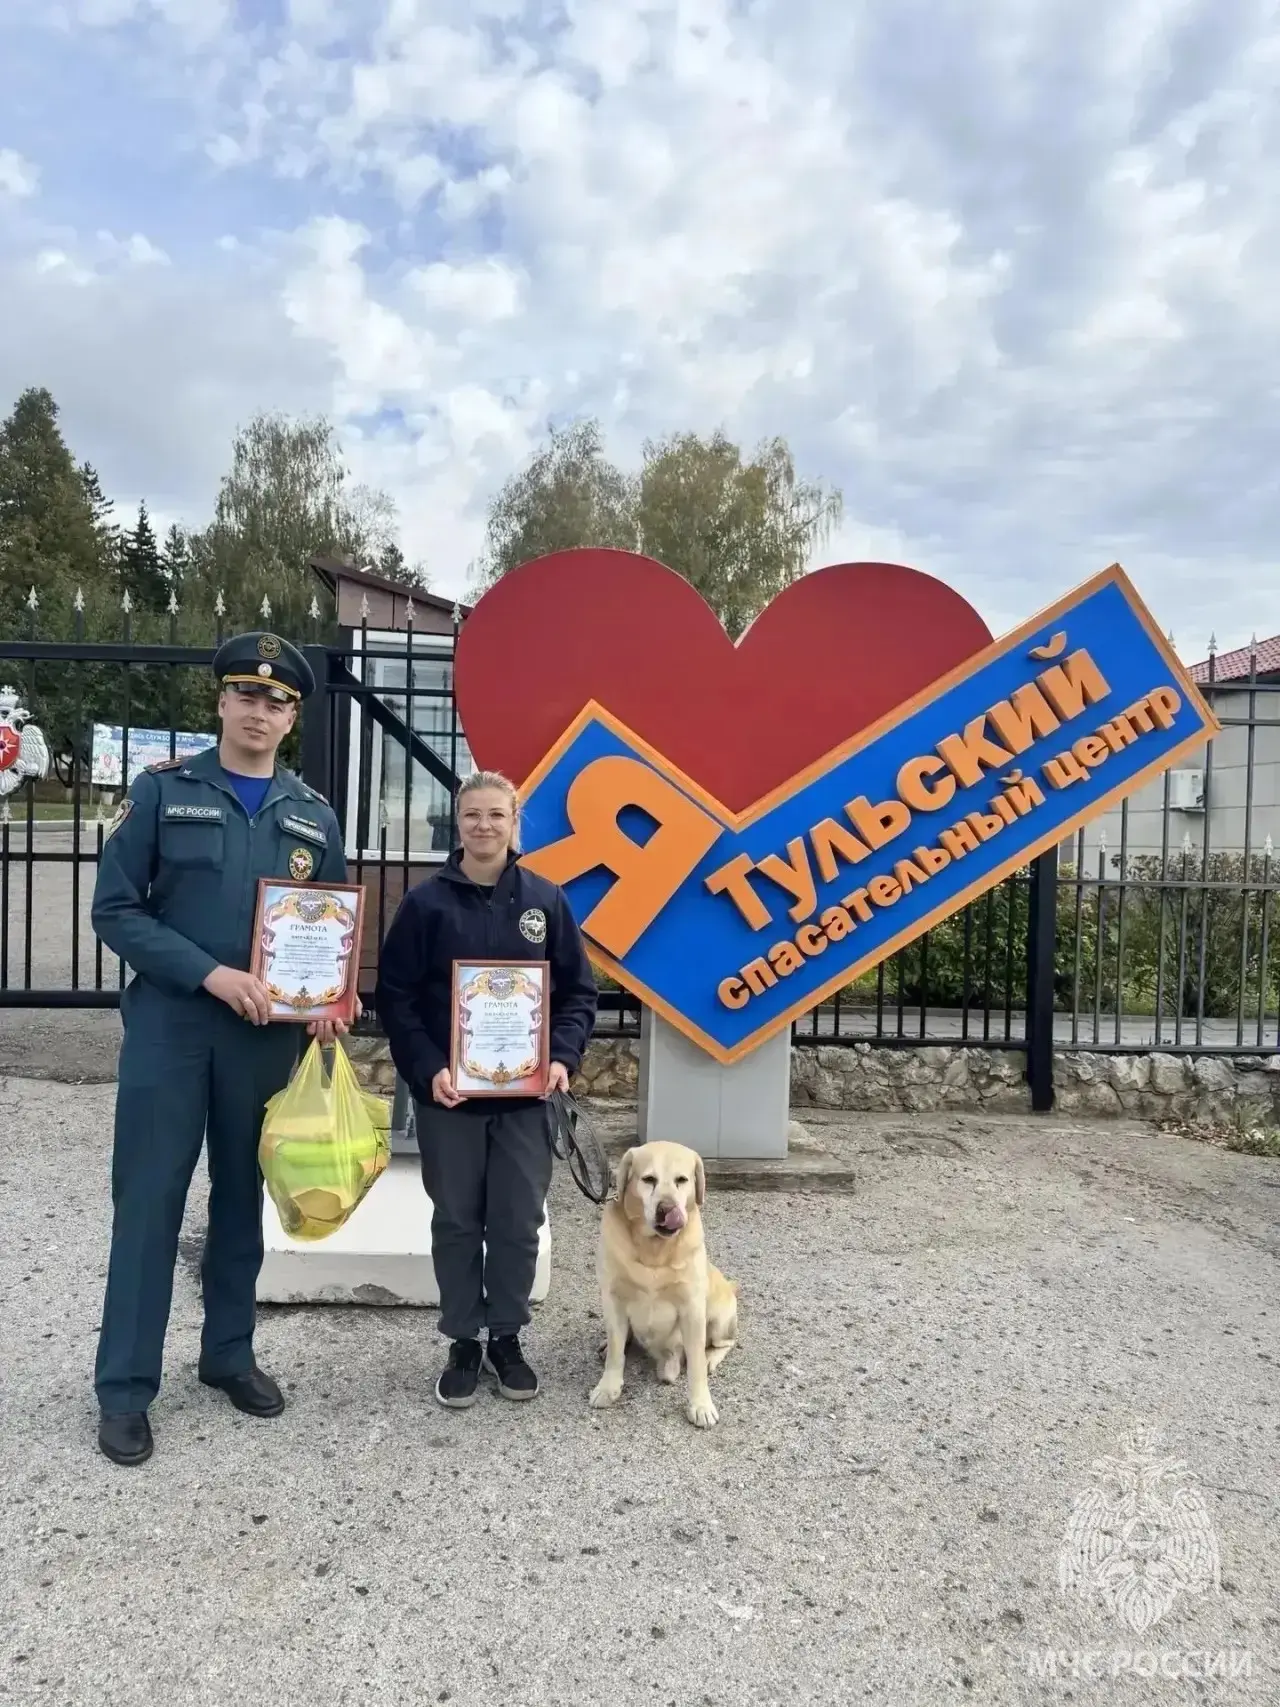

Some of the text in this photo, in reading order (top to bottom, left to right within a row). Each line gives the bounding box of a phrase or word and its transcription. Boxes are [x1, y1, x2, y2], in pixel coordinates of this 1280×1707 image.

[167, 806, 220, 817] МЧС РОССИИ
[704, 631, 1112, 932] Тульский
[516, 756, 726, 960] Я
[718, 685, 1182, 1010] спасательный центр
[290, 923, 328, 932] ГРАМОТА
[484, 1001, 518, 1009] ГРАМОТА
